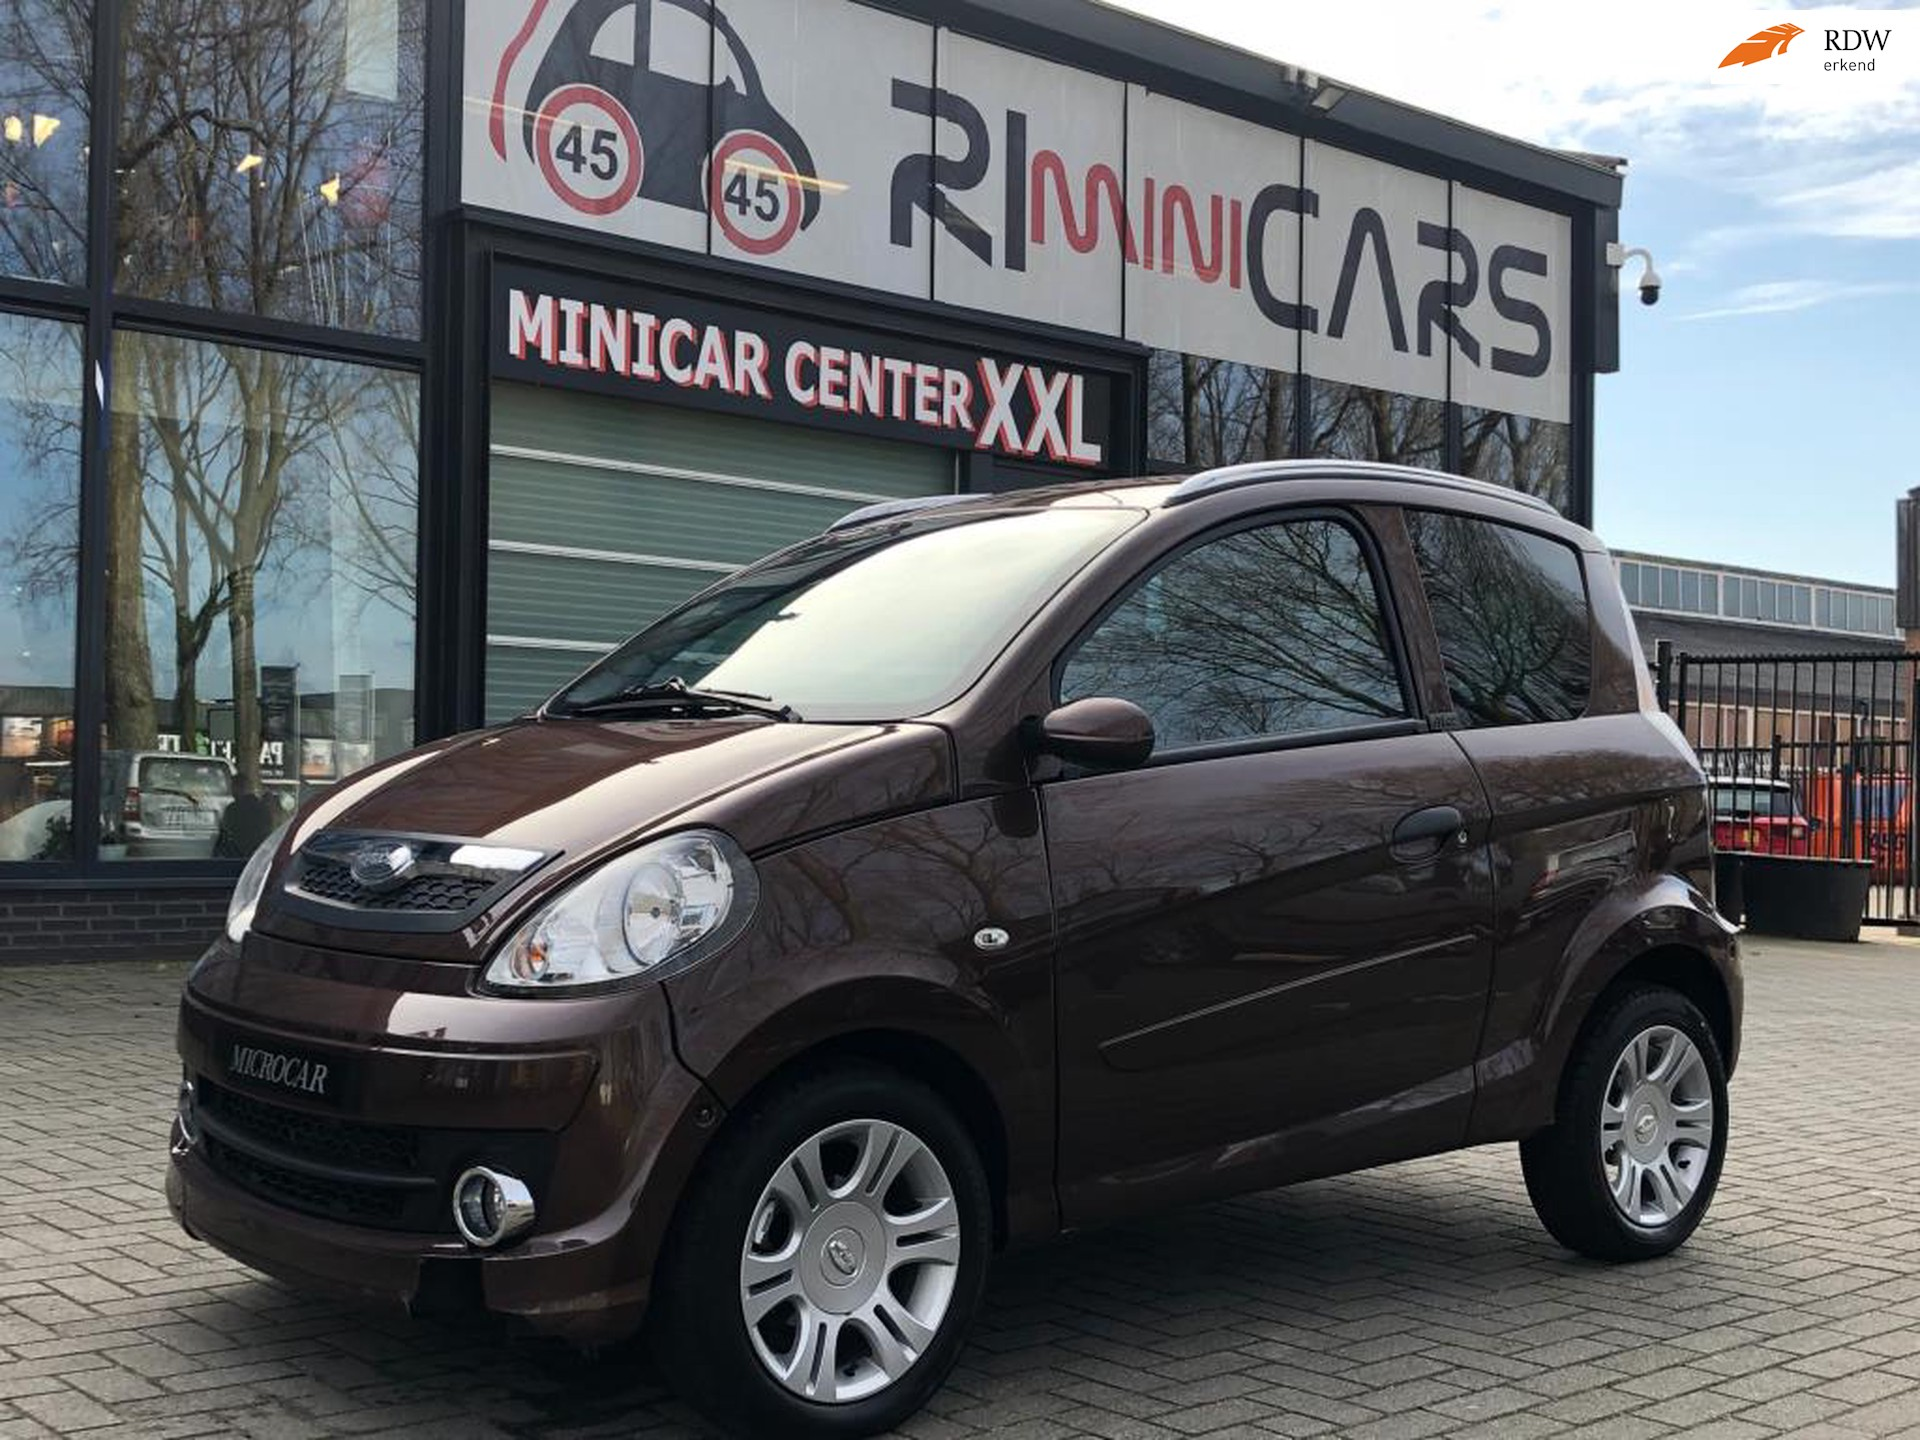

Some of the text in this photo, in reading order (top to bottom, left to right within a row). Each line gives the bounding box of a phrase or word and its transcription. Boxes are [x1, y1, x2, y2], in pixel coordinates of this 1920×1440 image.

[555, 125, 618, 181] 45
[723, 166, 780, 222] 45
[508, 288, 1102, 465] MINICAR CENTER XXL
[229, 1044, 328, 1094] MICROCAR
